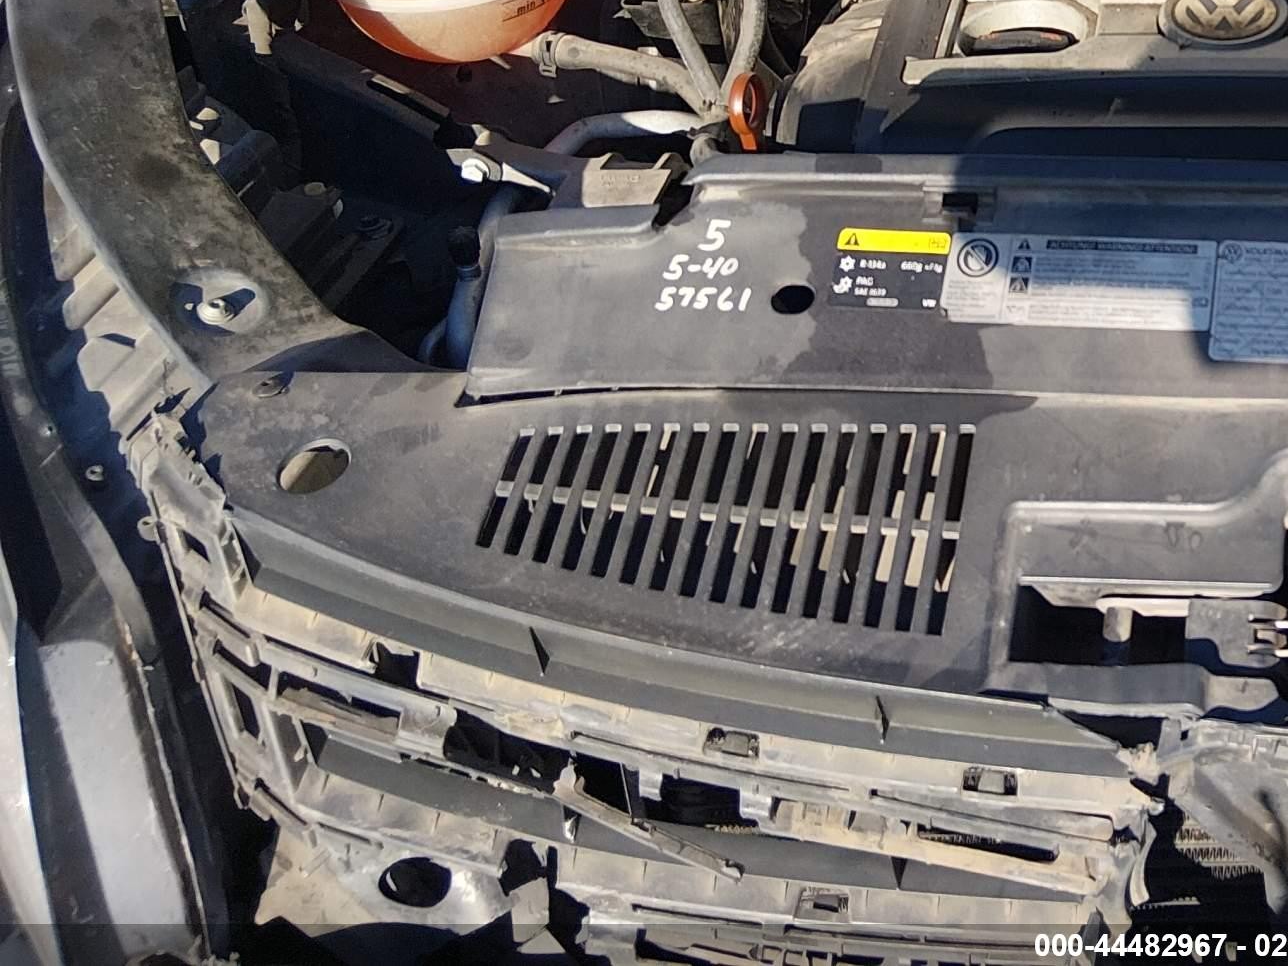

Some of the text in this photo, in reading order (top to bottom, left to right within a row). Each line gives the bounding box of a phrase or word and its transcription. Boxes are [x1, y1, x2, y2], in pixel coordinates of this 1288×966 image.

[517, 0, 536, 15] min
[697, 218, 731, 252] 5
[662, 253, 739, 281] 5-40
[654, 285, 752, 312] 57561
